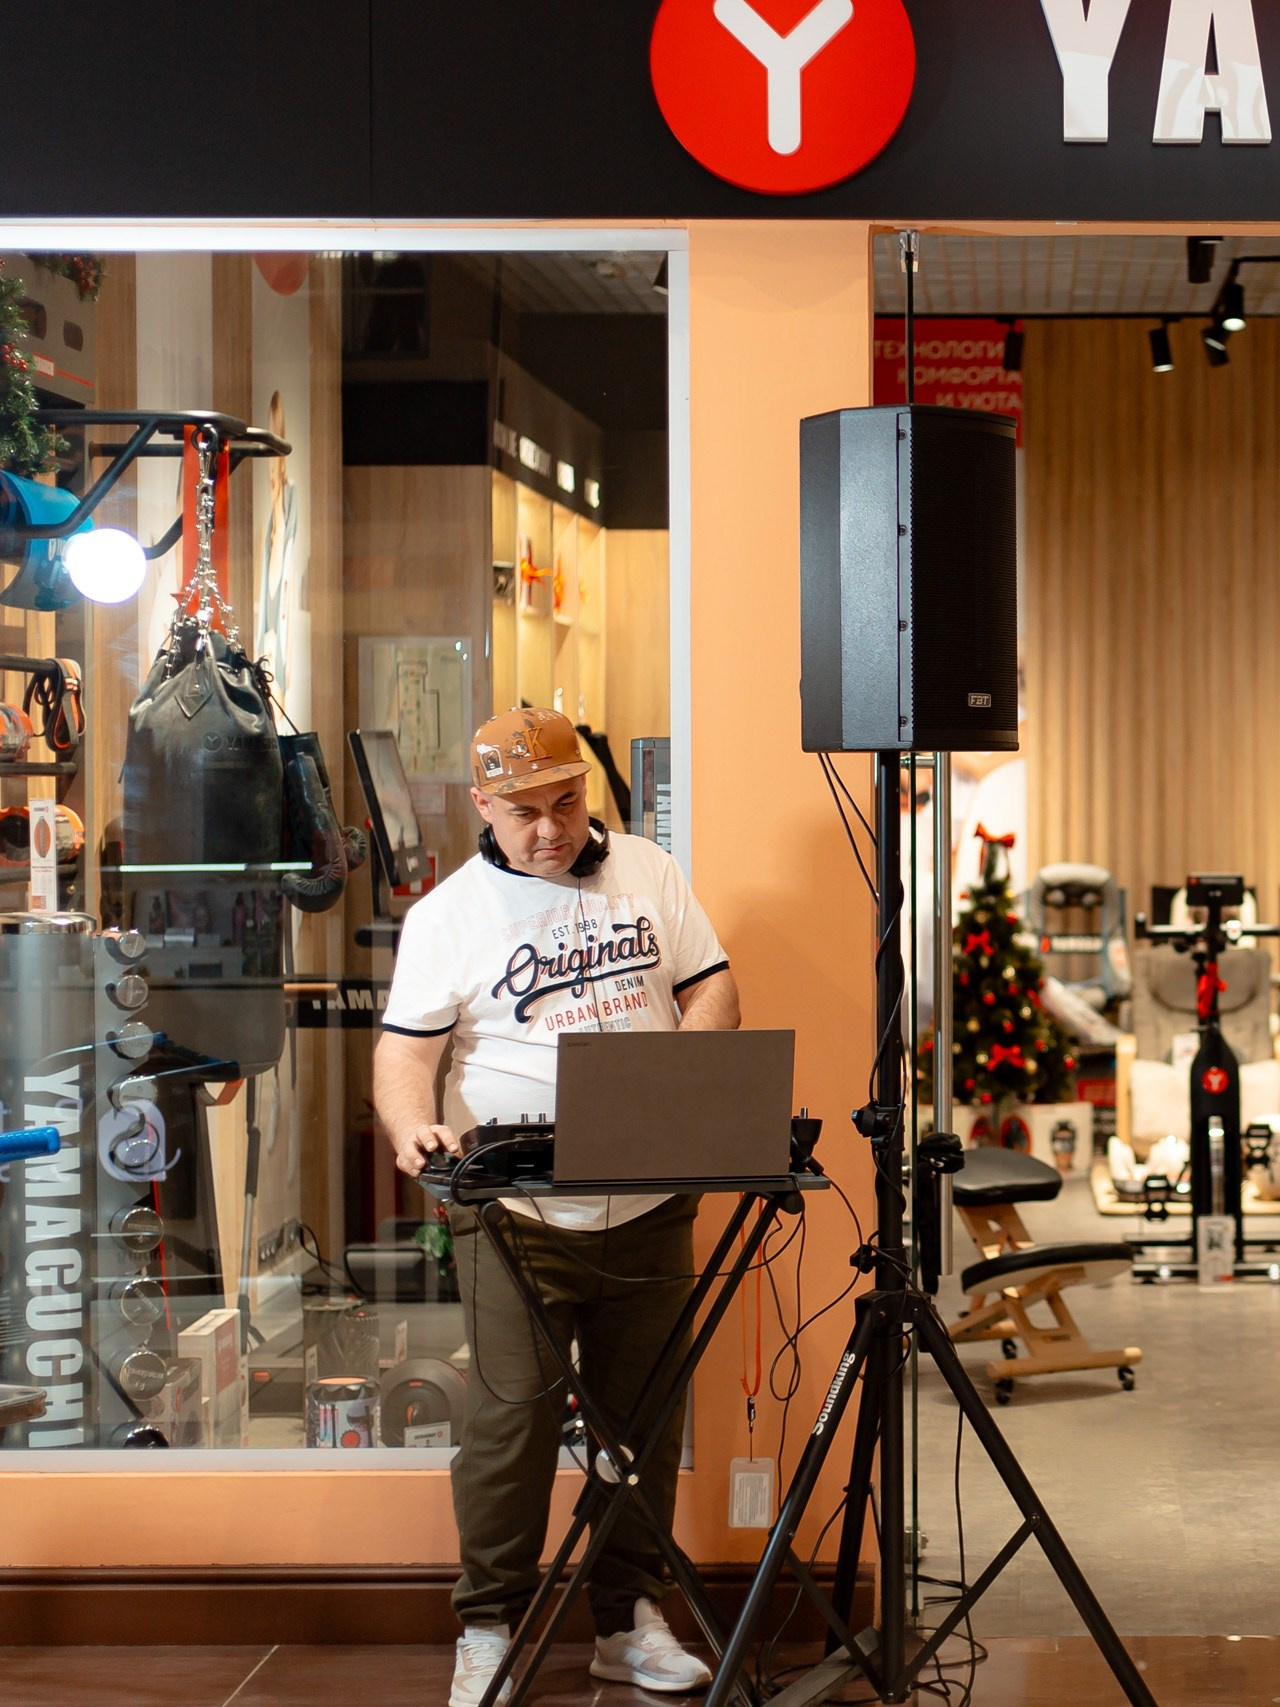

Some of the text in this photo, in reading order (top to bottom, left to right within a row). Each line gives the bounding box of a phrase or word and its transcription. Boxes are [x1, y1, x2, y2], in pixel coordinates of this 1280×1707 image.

[501, 892, 635, 942] SUPERIOR QUALITY
[491, 916, 662, 1000] Originals
[614, 975, 645, 992] DENIM
[544, 991, 649, 1031] URBAN BRAND
[24, 1064, 85, 1448] YAMAGUCHI
[812, 1353, 856, 1436] Soundking
